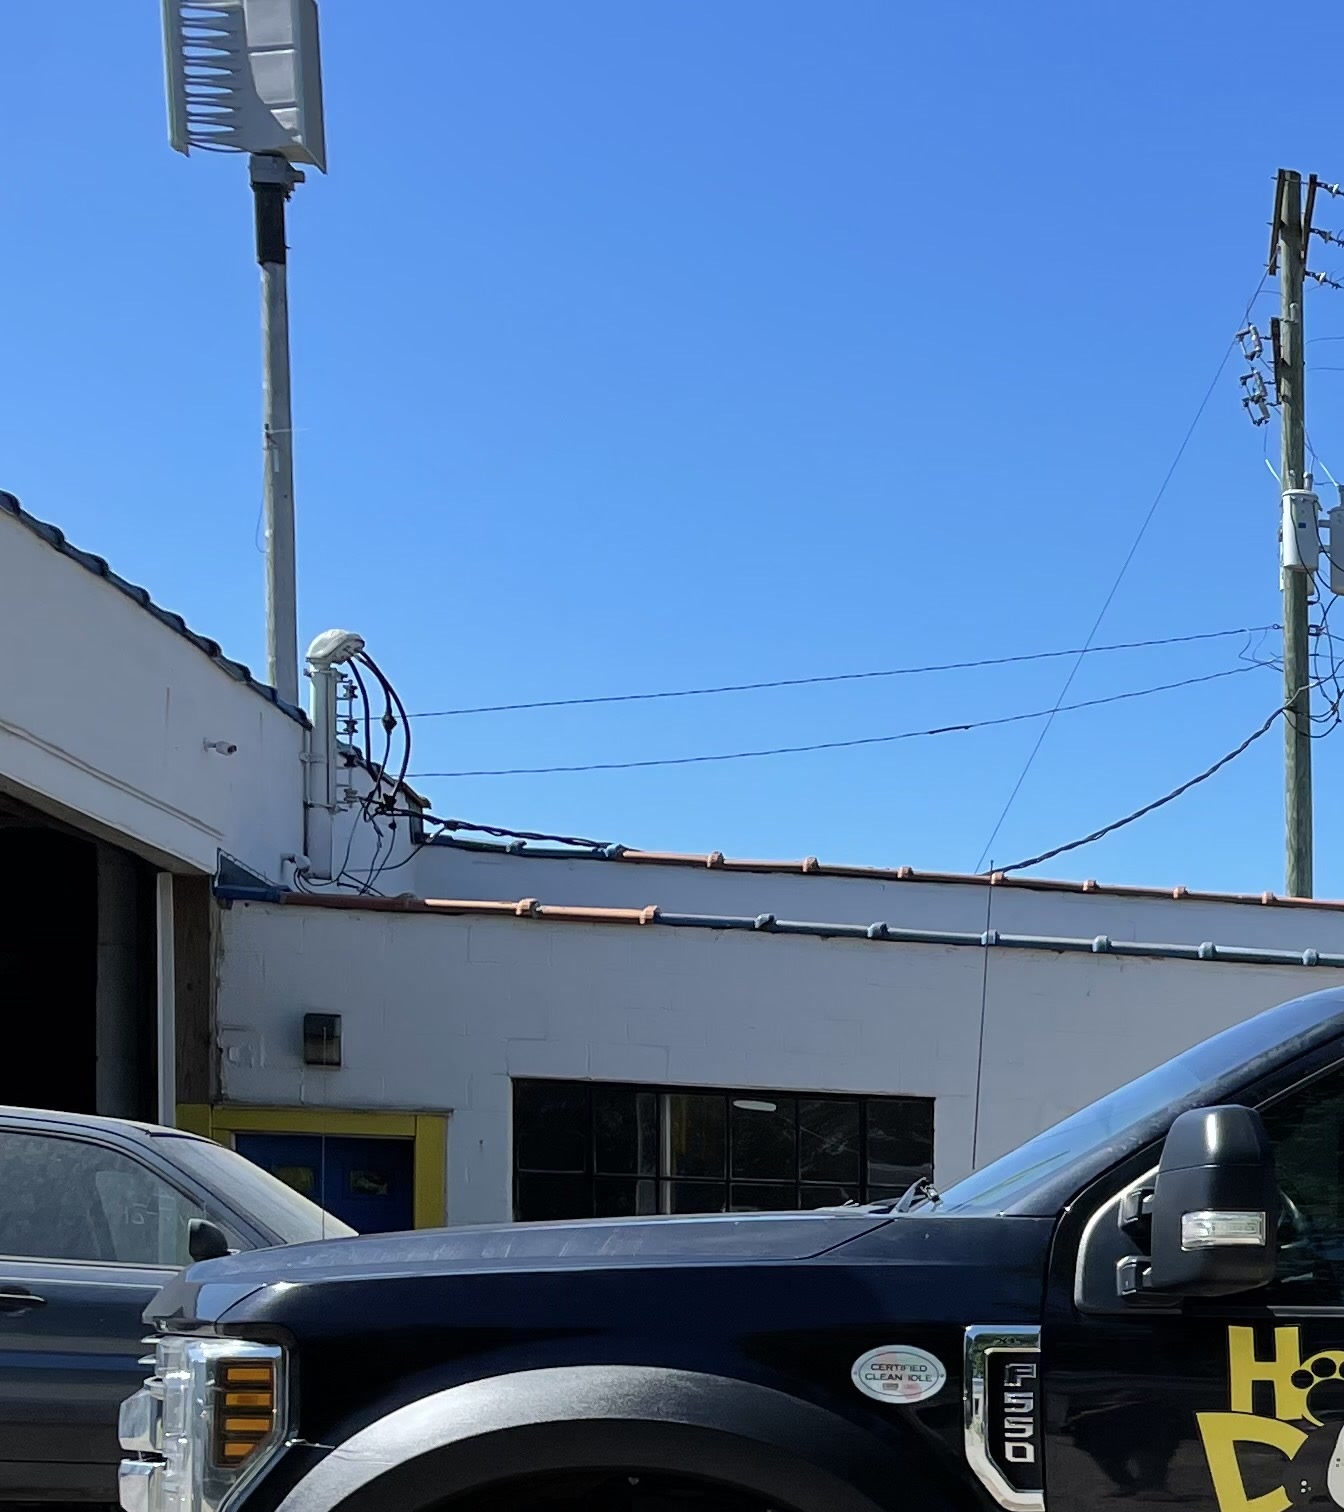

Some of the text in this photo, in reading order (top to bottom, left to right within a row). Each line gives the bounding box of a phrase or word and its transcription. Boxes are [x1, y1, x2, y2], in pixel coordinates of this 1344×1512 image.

[871, 1363, 928, 1372] CERTIFIED
[865, 1372, 933, 1382] CLEAN IDLE
[1004, 1362, 1037, 1463] F550
